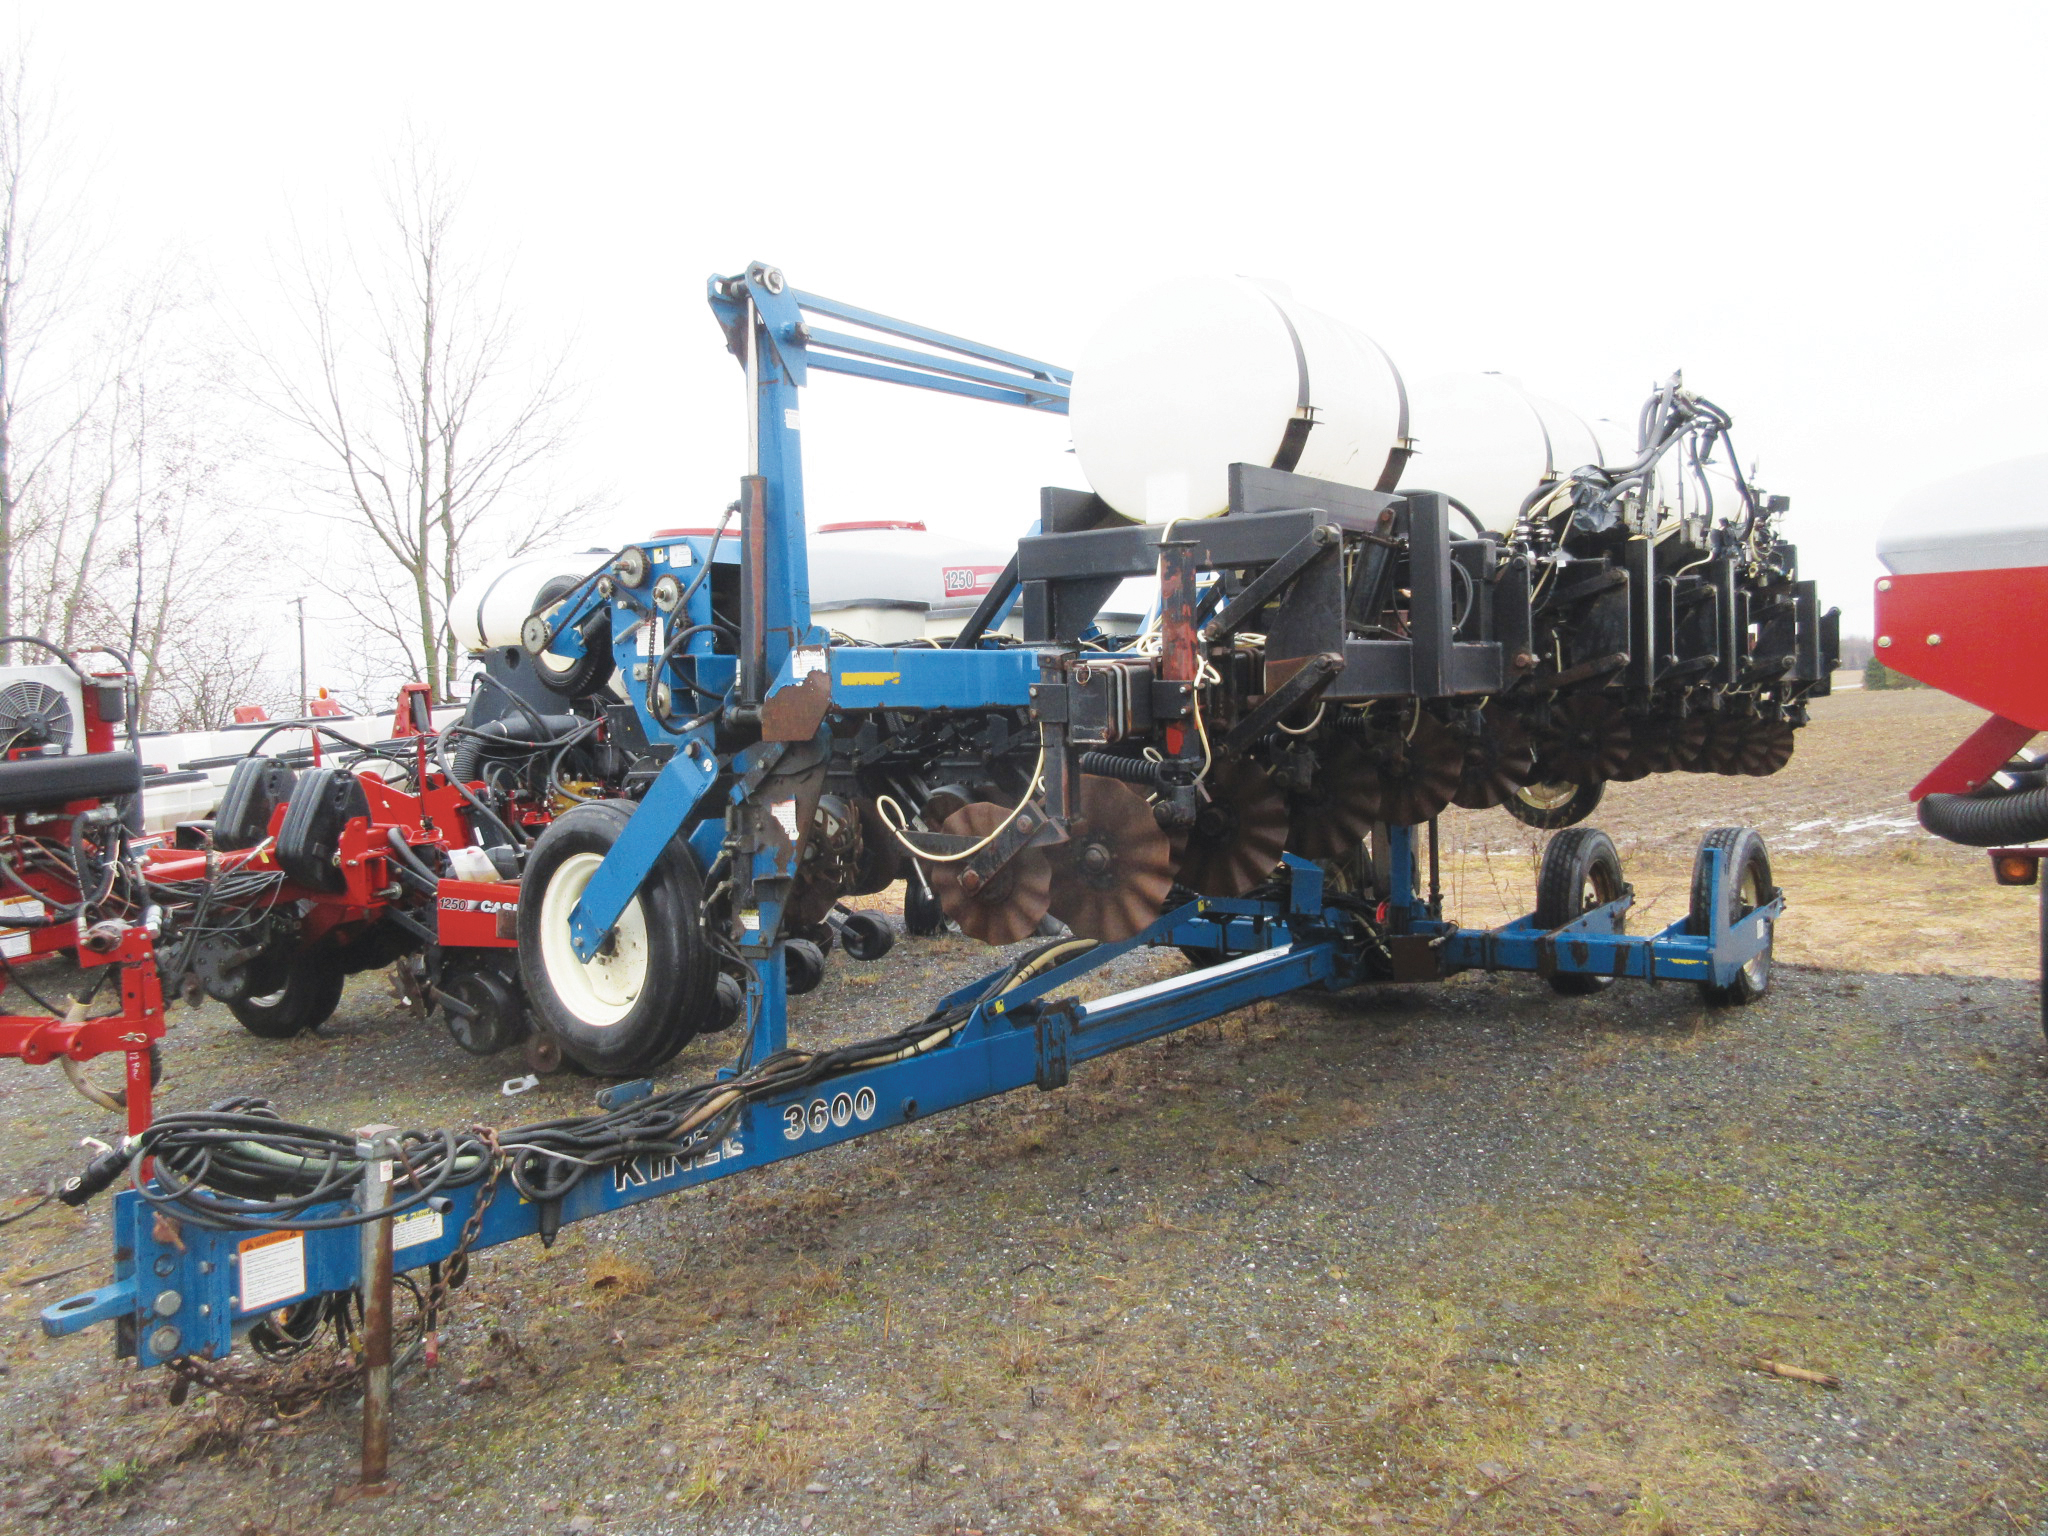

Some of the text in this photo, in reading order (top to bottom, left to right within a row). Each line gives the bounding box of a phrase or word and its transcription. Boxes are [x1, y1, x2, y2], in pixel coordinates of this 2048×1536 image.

[945, 569, 974, 590] 1250
[440, 897, 467, 912] 1250
[783, 1086, 876, 1141] 3600
